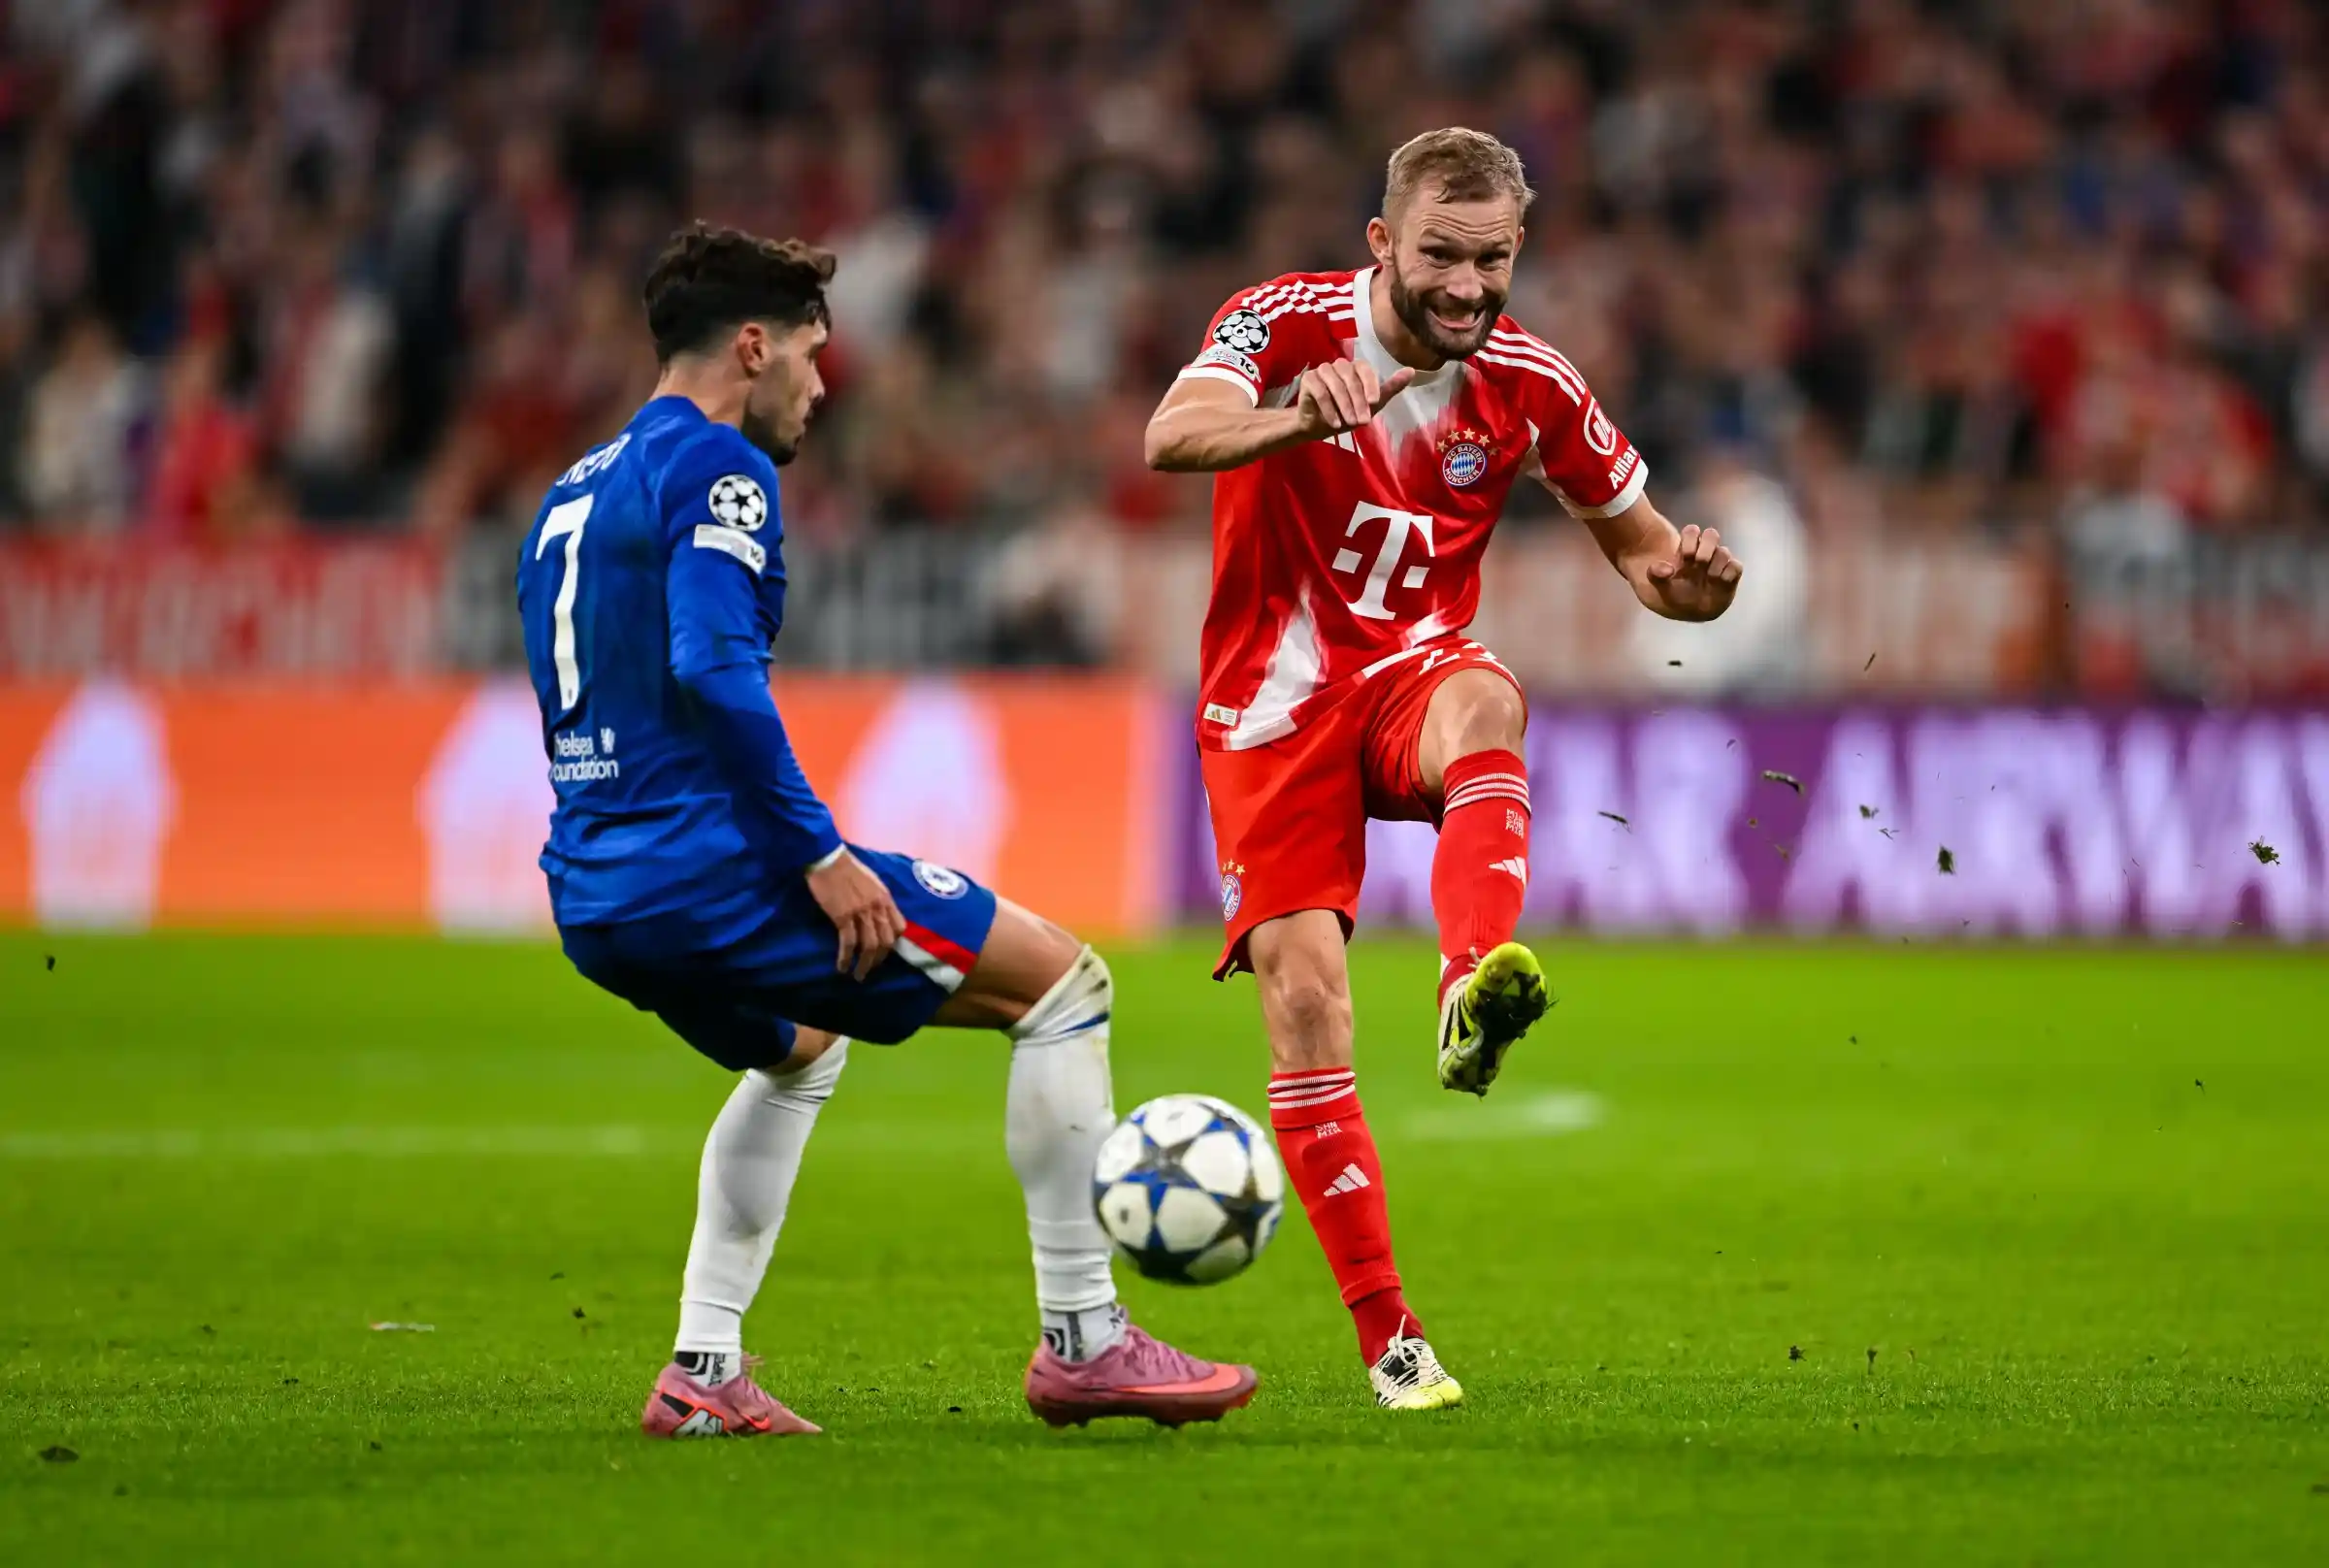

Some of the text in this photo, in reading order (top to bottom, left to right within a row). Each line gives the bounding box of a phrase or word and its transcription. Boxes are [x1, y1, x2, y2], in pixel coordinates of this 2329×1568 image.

[1458, 445, 1484, 464] BAYERN
[1332, 500, 1436, 621] T
[535, 493, 595, 711] 7
[553, 730, 595, 757] helsea
[549, 754, 619, 782] oundation
